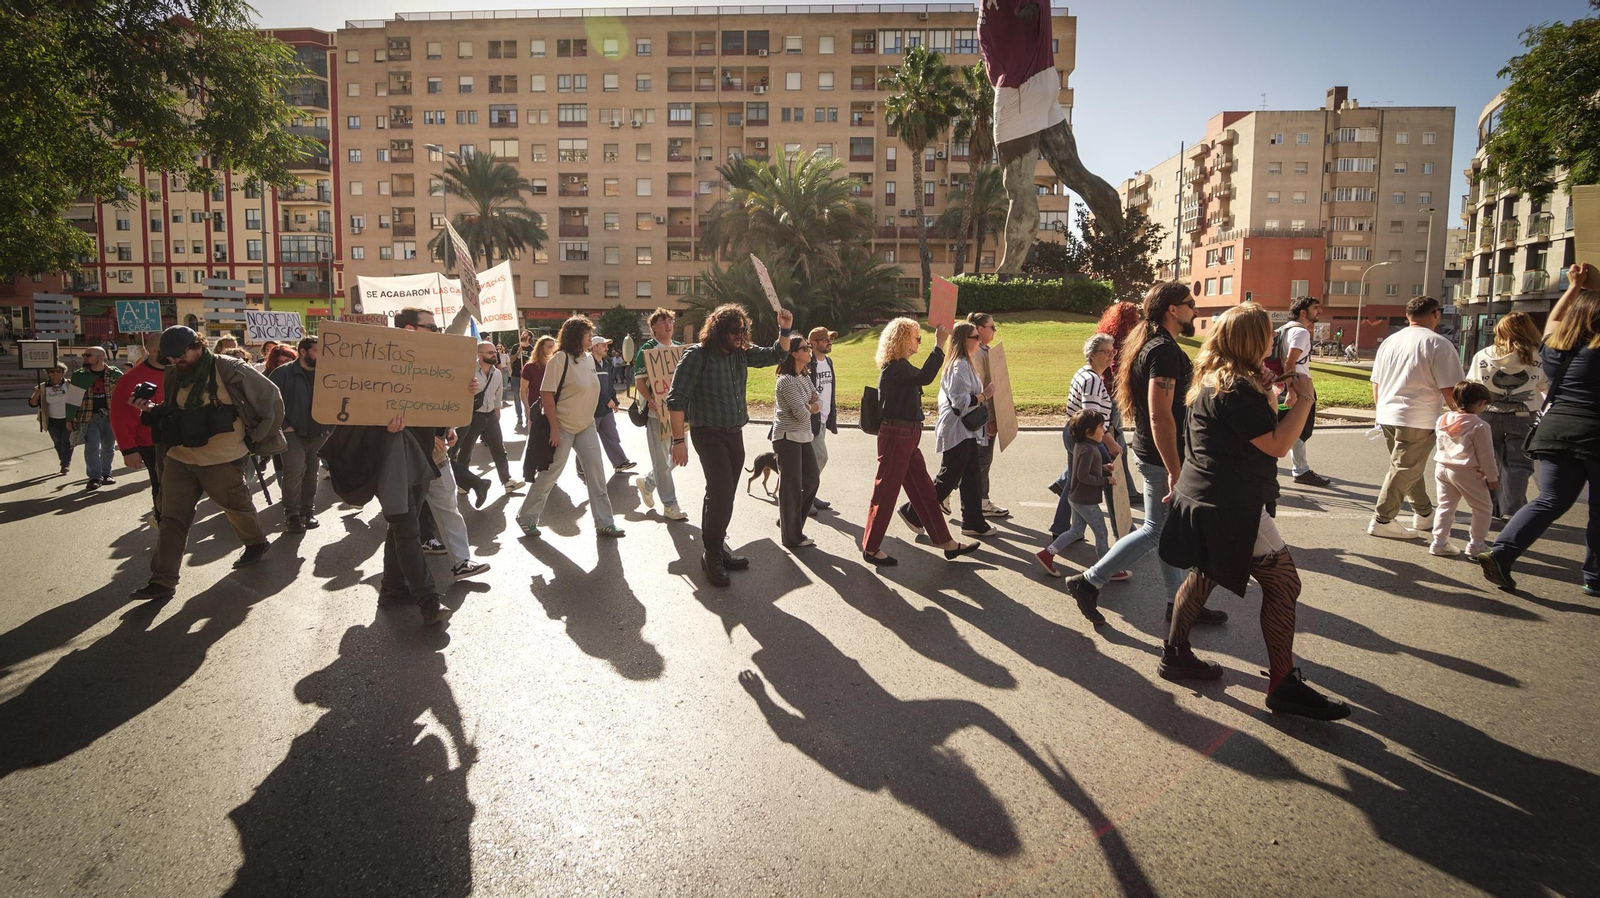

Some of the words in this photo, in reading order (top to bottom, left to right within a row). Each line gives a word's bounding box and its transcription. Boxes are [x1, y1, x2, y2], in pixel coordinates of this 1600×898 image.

[366, 290, 378, 298] SE
[380, 288, 430, 298] ACABARON
[432, 286, 448, 294] LAS
[246, 312, 268, 326] NOS
[270, 313, 302, 327] DEJAN
[356, 314, 388, 326] NEGOCIO
[250, 326, 267, 339] SIN
[266, 326, 302, 338] CASAS
[322, 332, 416, 362] Rentistas
[391, 362, 456, 381] culpables,
[322, 374, 412, 394] Gobiernos
[386, 398, 460, 417] responsables
